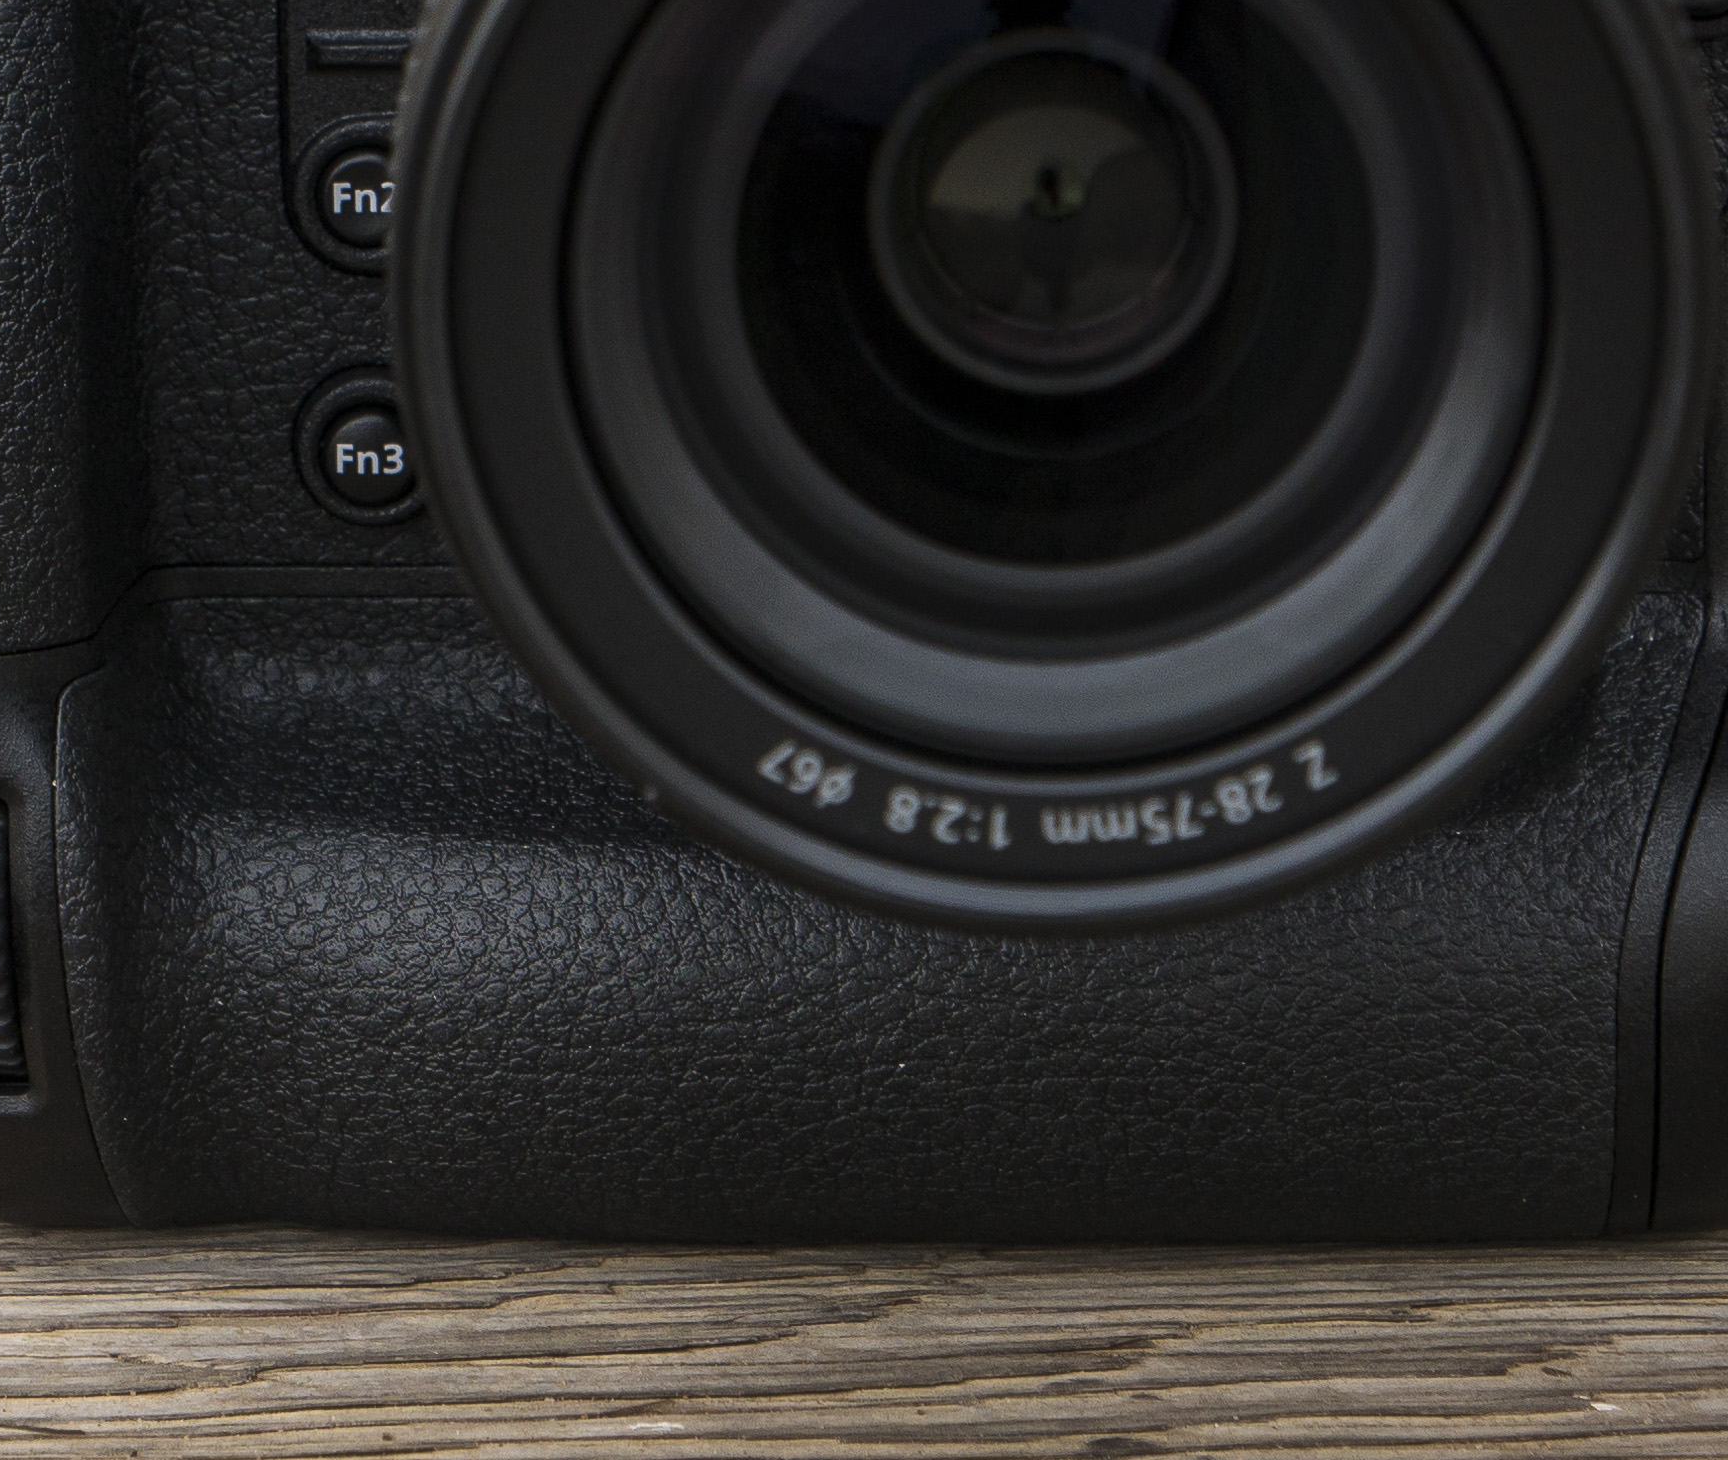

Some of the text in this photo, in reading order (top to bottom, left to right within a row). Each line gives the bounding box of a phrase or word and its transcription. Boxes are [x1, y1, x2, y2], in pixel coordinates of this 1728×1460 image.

[332, 181, 397, 214] Fn2
[336, 443, 404, 475] Fn3
[1293, 741, 1339, 791] Z
[886, 785, 1011, 851] 1:2.8
[1040, 765, 1283, 845] 28-75mm
